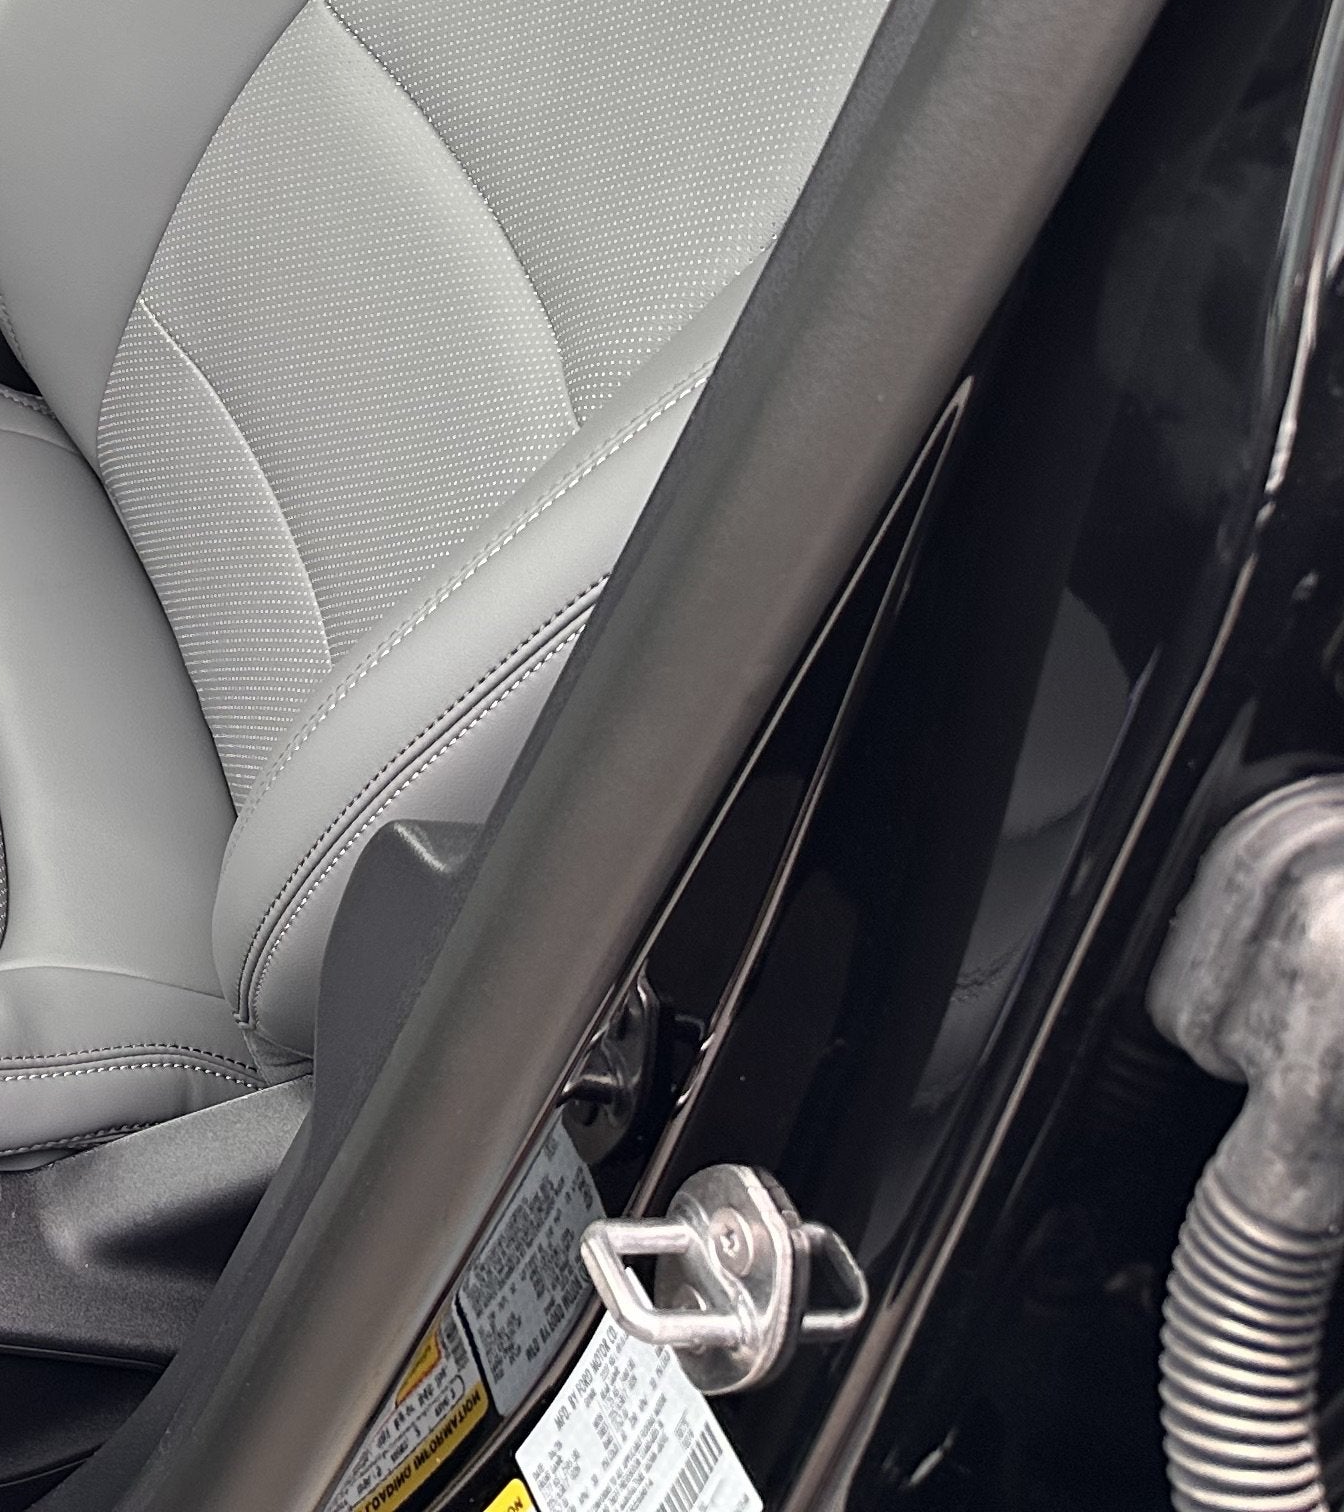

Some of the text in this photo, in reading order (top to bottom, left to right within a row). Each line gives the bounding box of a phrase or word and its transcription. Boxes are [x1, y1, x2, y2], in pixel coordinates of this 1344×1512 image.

[567, 1390, 579, 1411] BY
[575, 1371, 594, 1398] FORD
[589, 1337, 611, 1374] MOTOR
